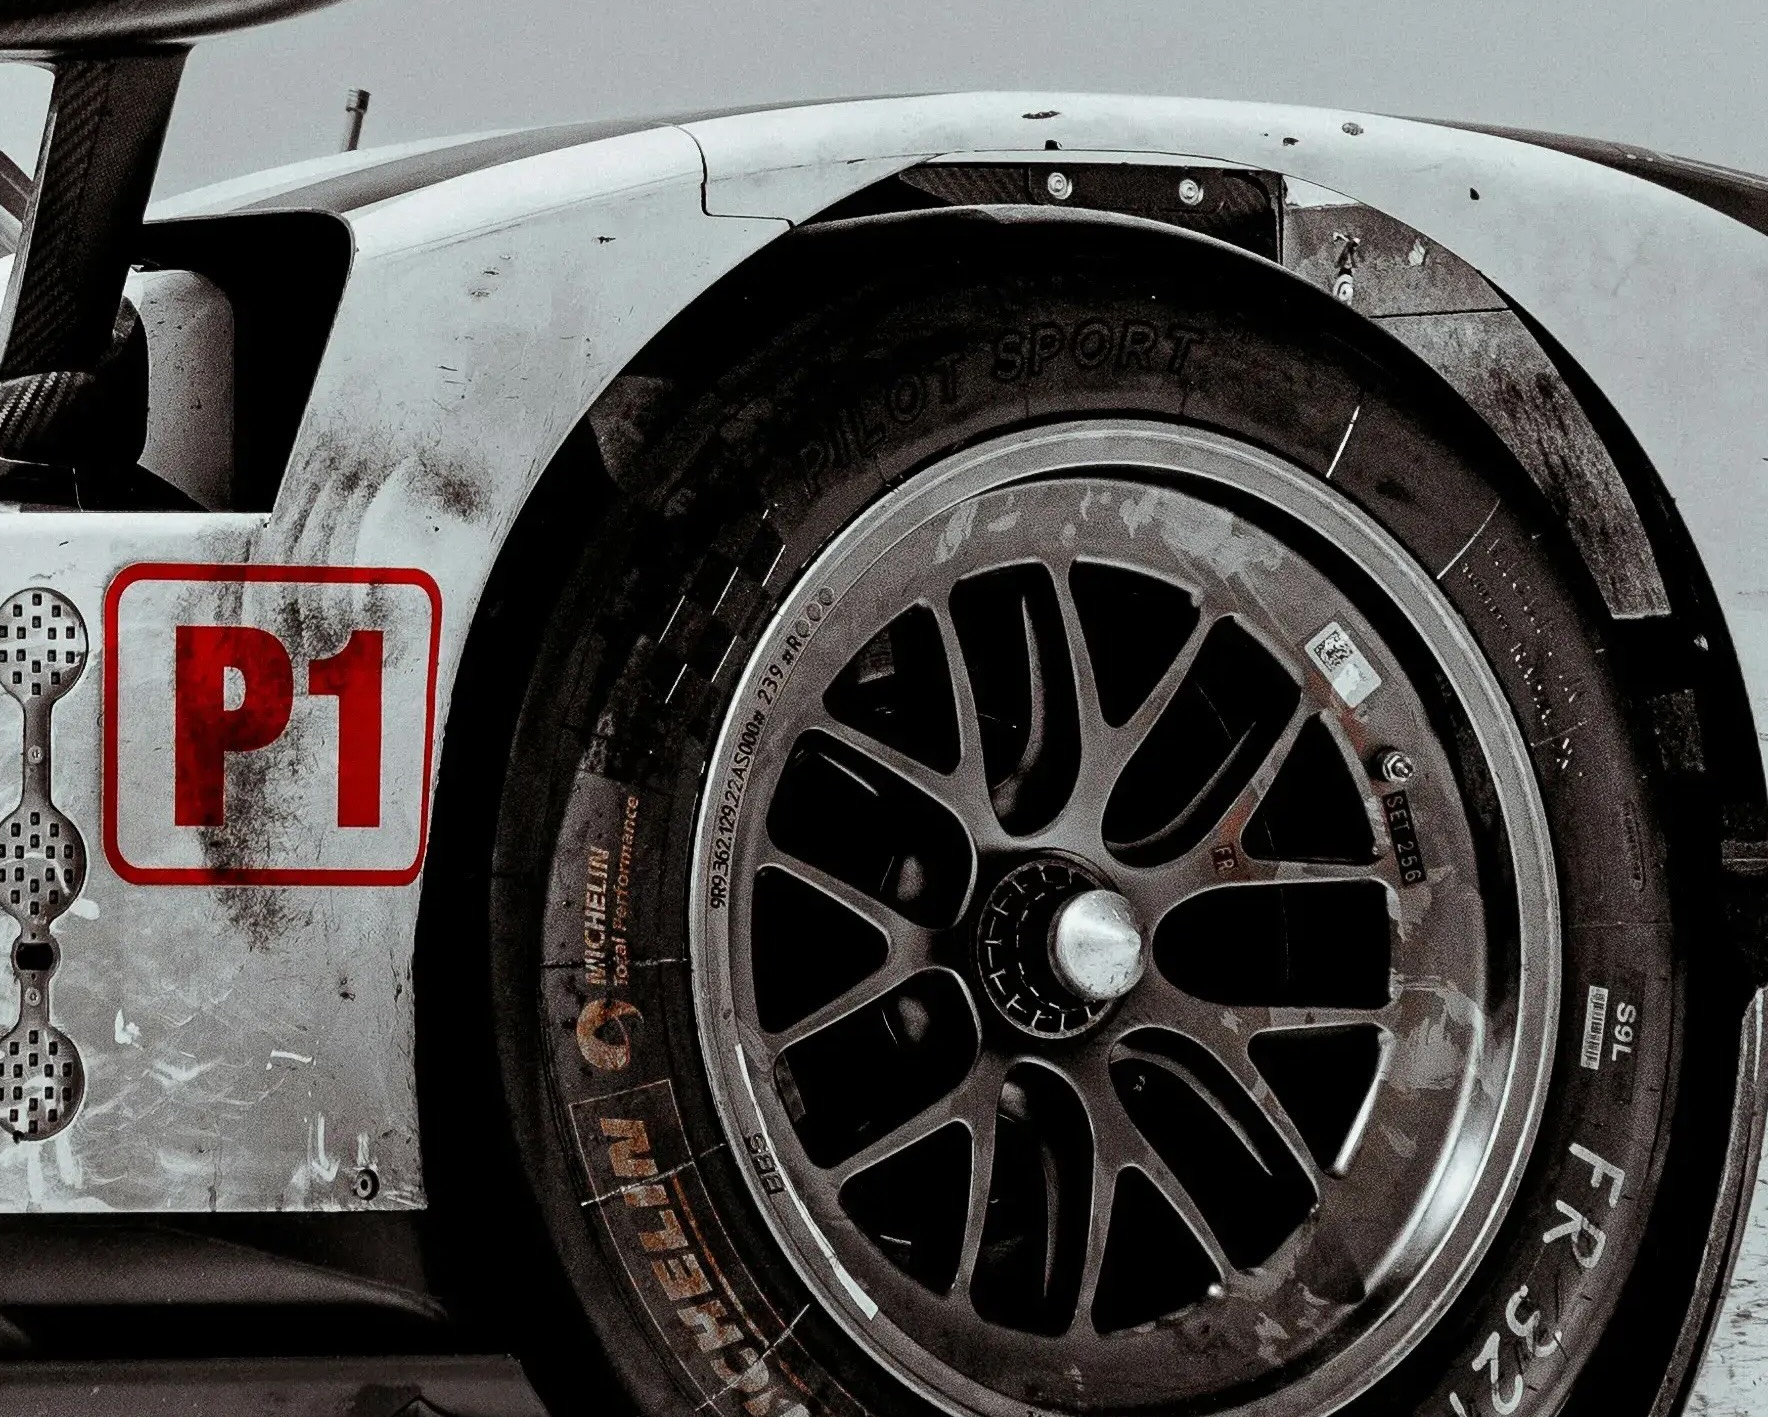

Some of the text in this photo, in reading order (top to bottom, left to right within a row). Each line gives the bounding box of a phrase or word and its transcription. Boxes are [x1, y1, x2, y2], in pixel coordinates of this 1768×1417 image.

[795, 318, 1206, 501] PILOT SPORT
[174, 625, 385, 828] P1
[611, 795, 641, 986] Total Performance
[1386, 794, 1422, 883] SET 256
[583, 846, 611, 985] MICHELIN
[1610, 1001, 1637, 1062] S9L
[1542, 1142, 1626, 1270] FR
